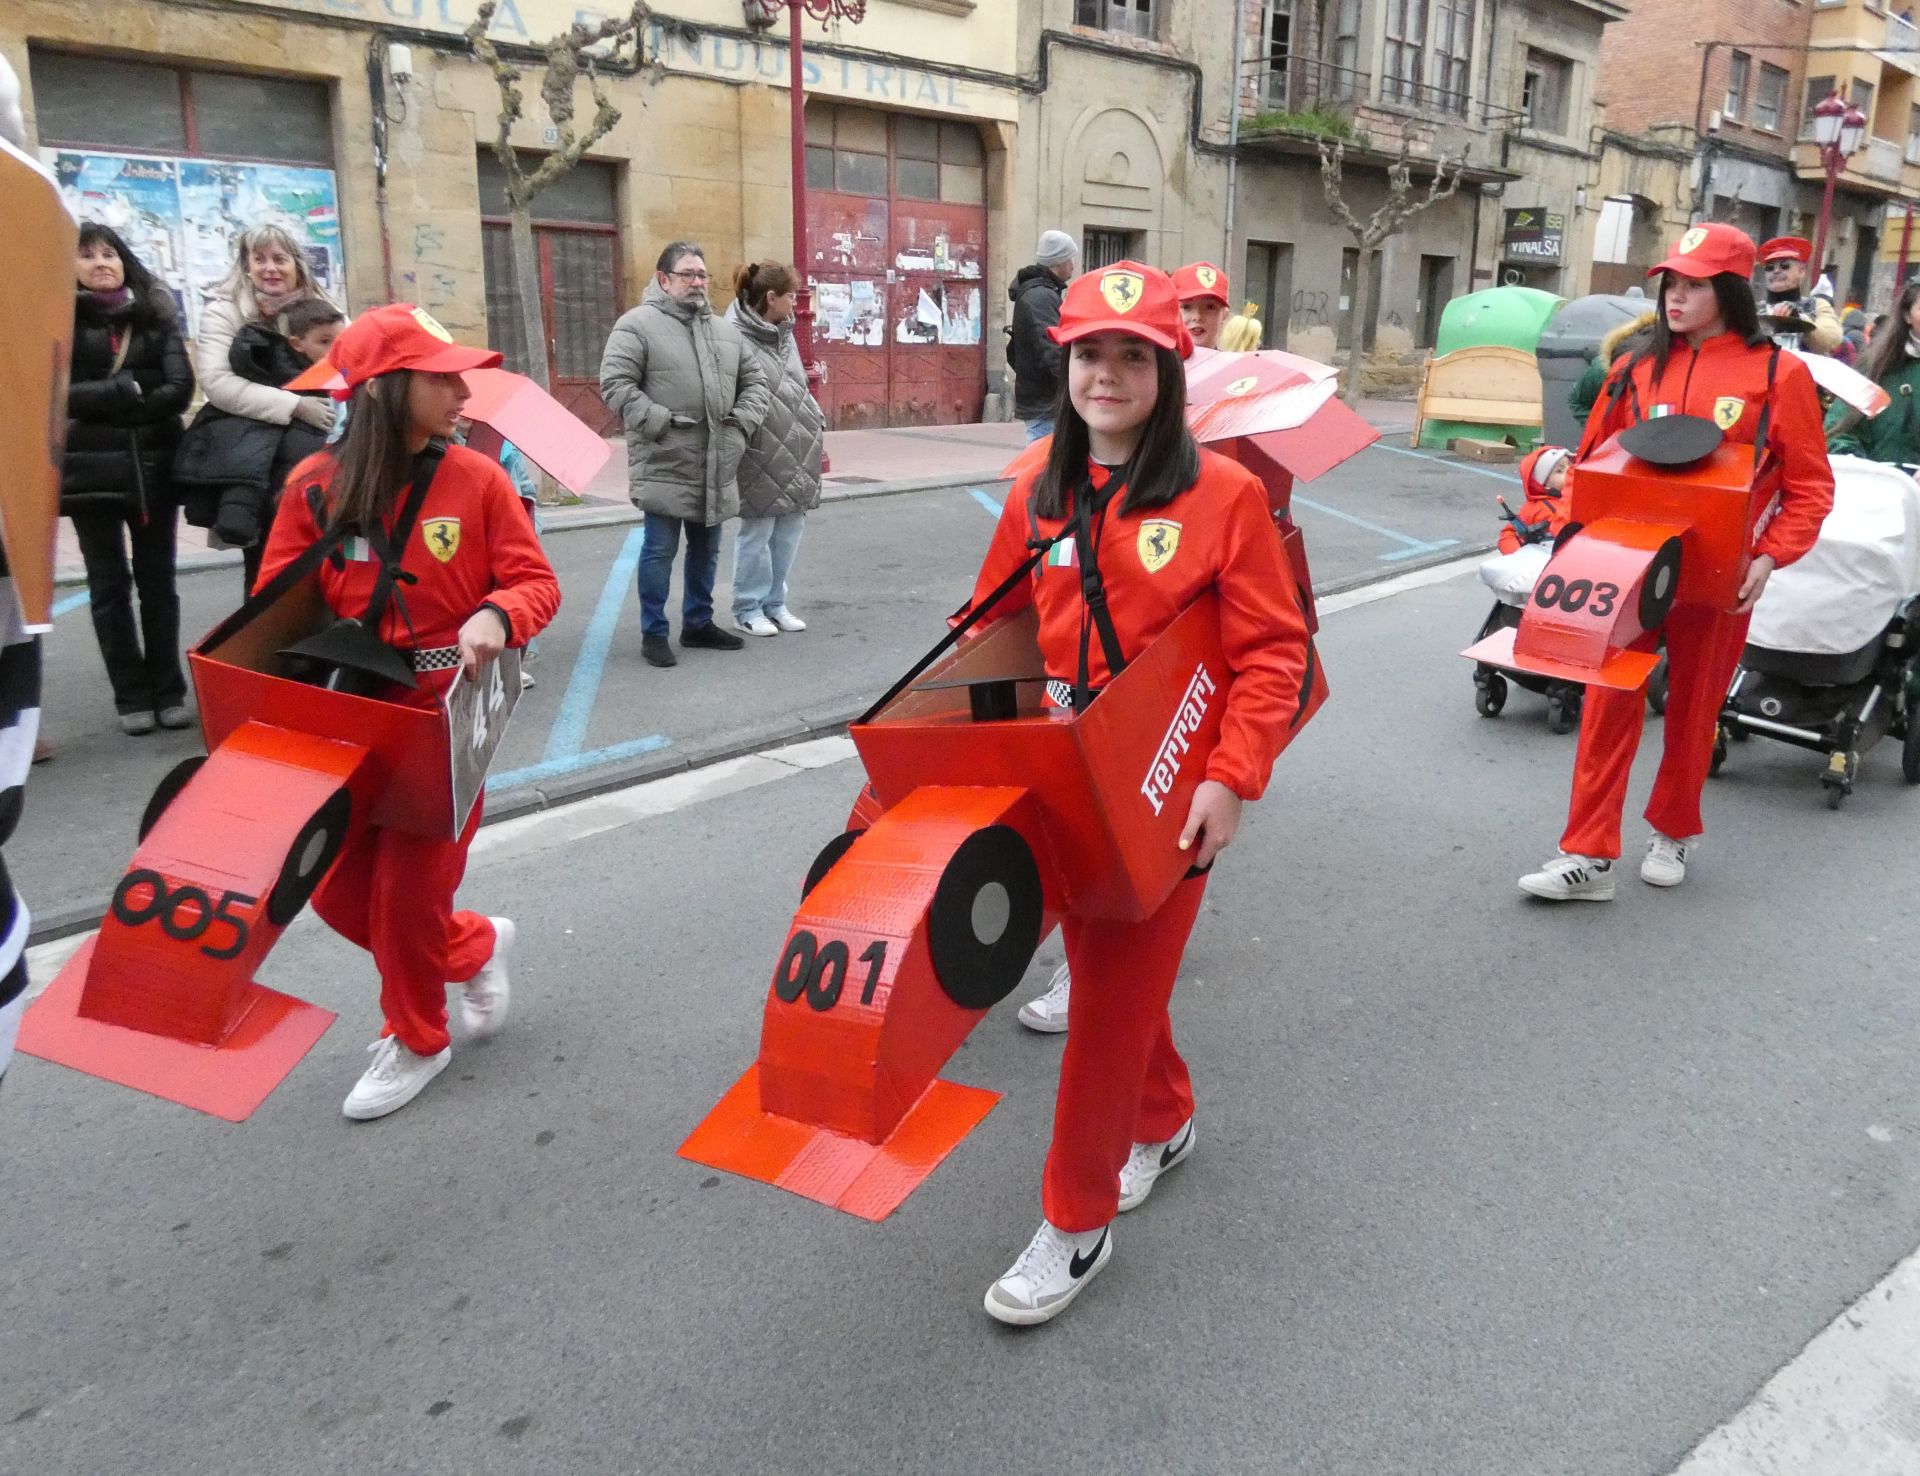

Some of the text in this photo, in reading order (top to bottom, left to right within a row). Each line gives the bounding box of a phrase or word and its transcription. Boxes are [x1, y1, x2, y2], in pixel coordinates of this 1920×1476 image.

[1511, 239, 1560, 257] VINALSA
[1534, 573, 1620, 617] 003
[1140, 662, 1216, 817] Ferrari
[112, 868, 258, 960] 005
[775, 929, 888, 1012] 001
